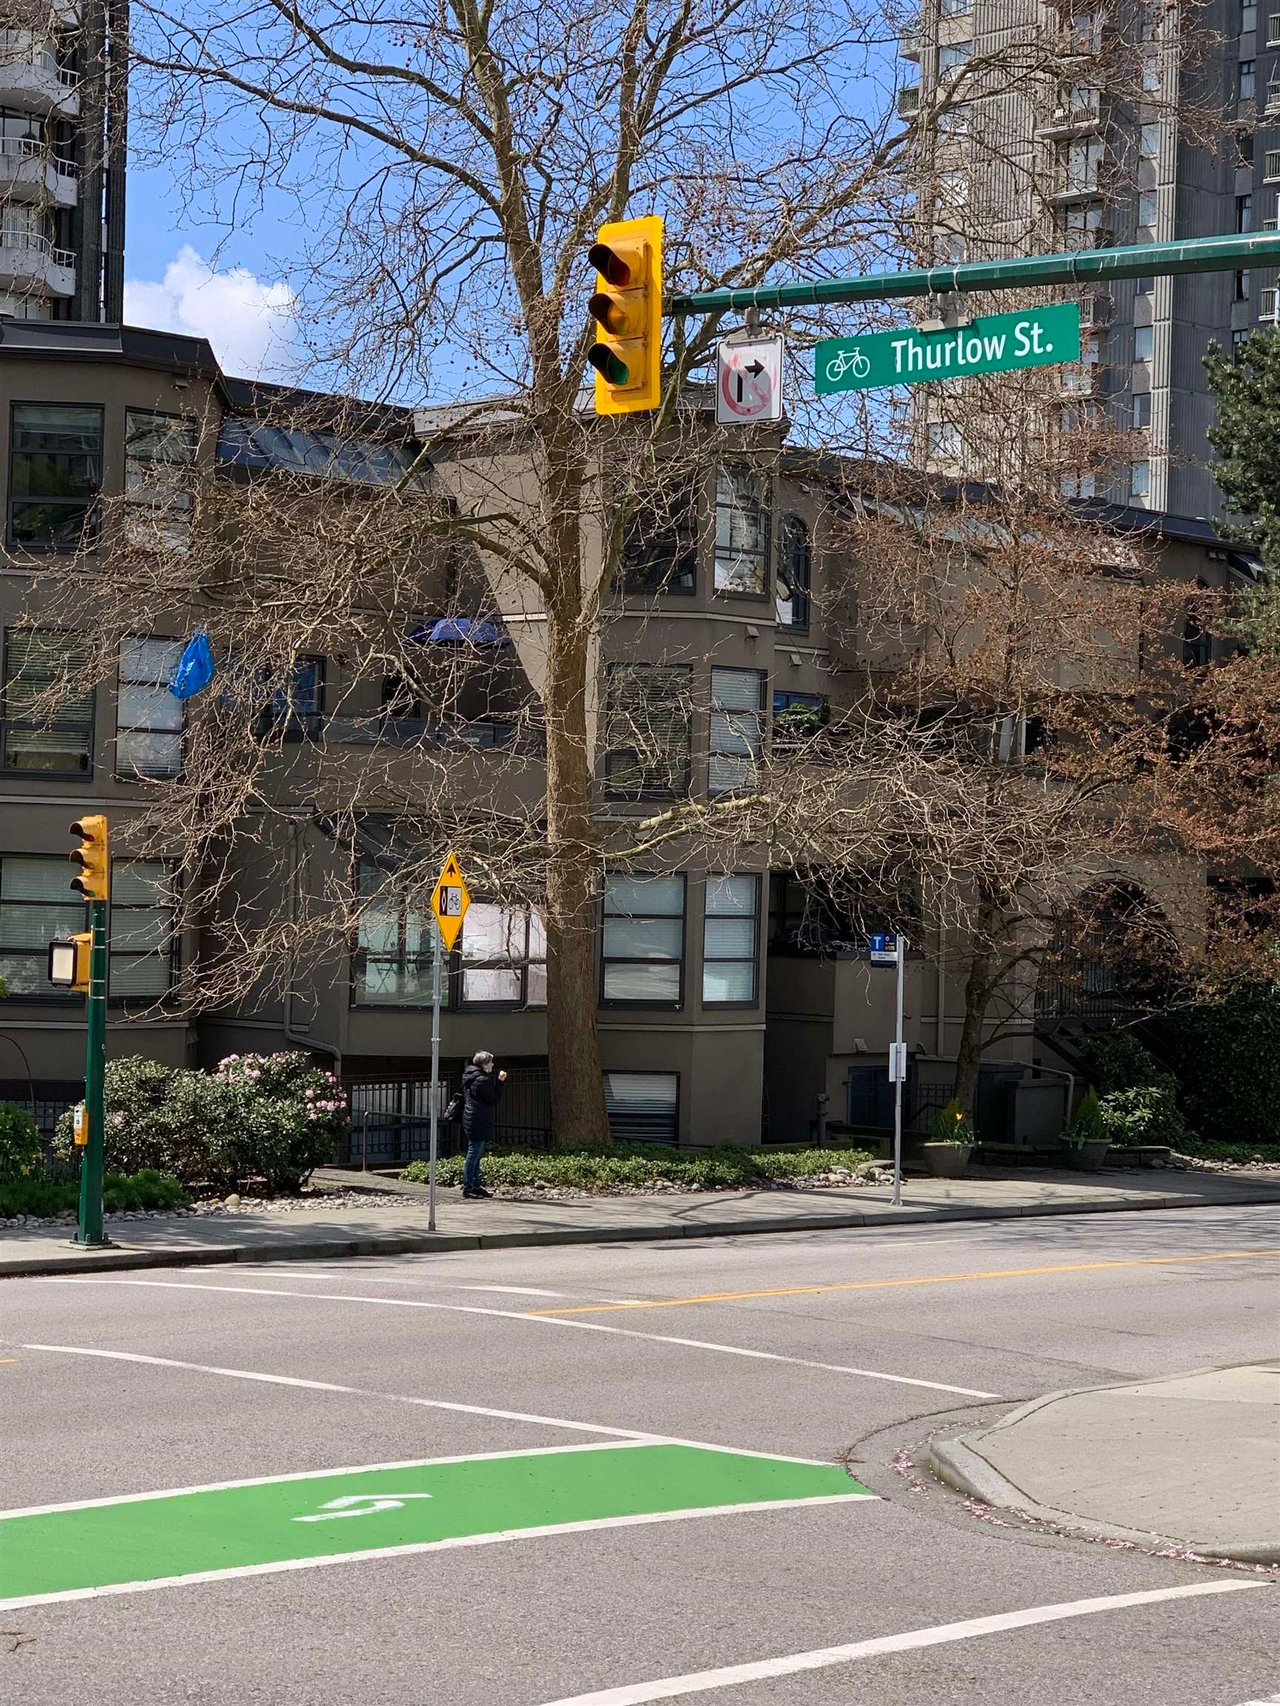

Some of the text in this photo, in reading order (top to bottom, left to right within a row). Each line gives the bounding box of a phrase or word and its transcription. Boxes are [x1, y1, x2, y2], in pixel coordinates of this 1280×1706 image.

[891, 321, 1053, 373] Thurlow St.
[873, 936, 881, 950] T
